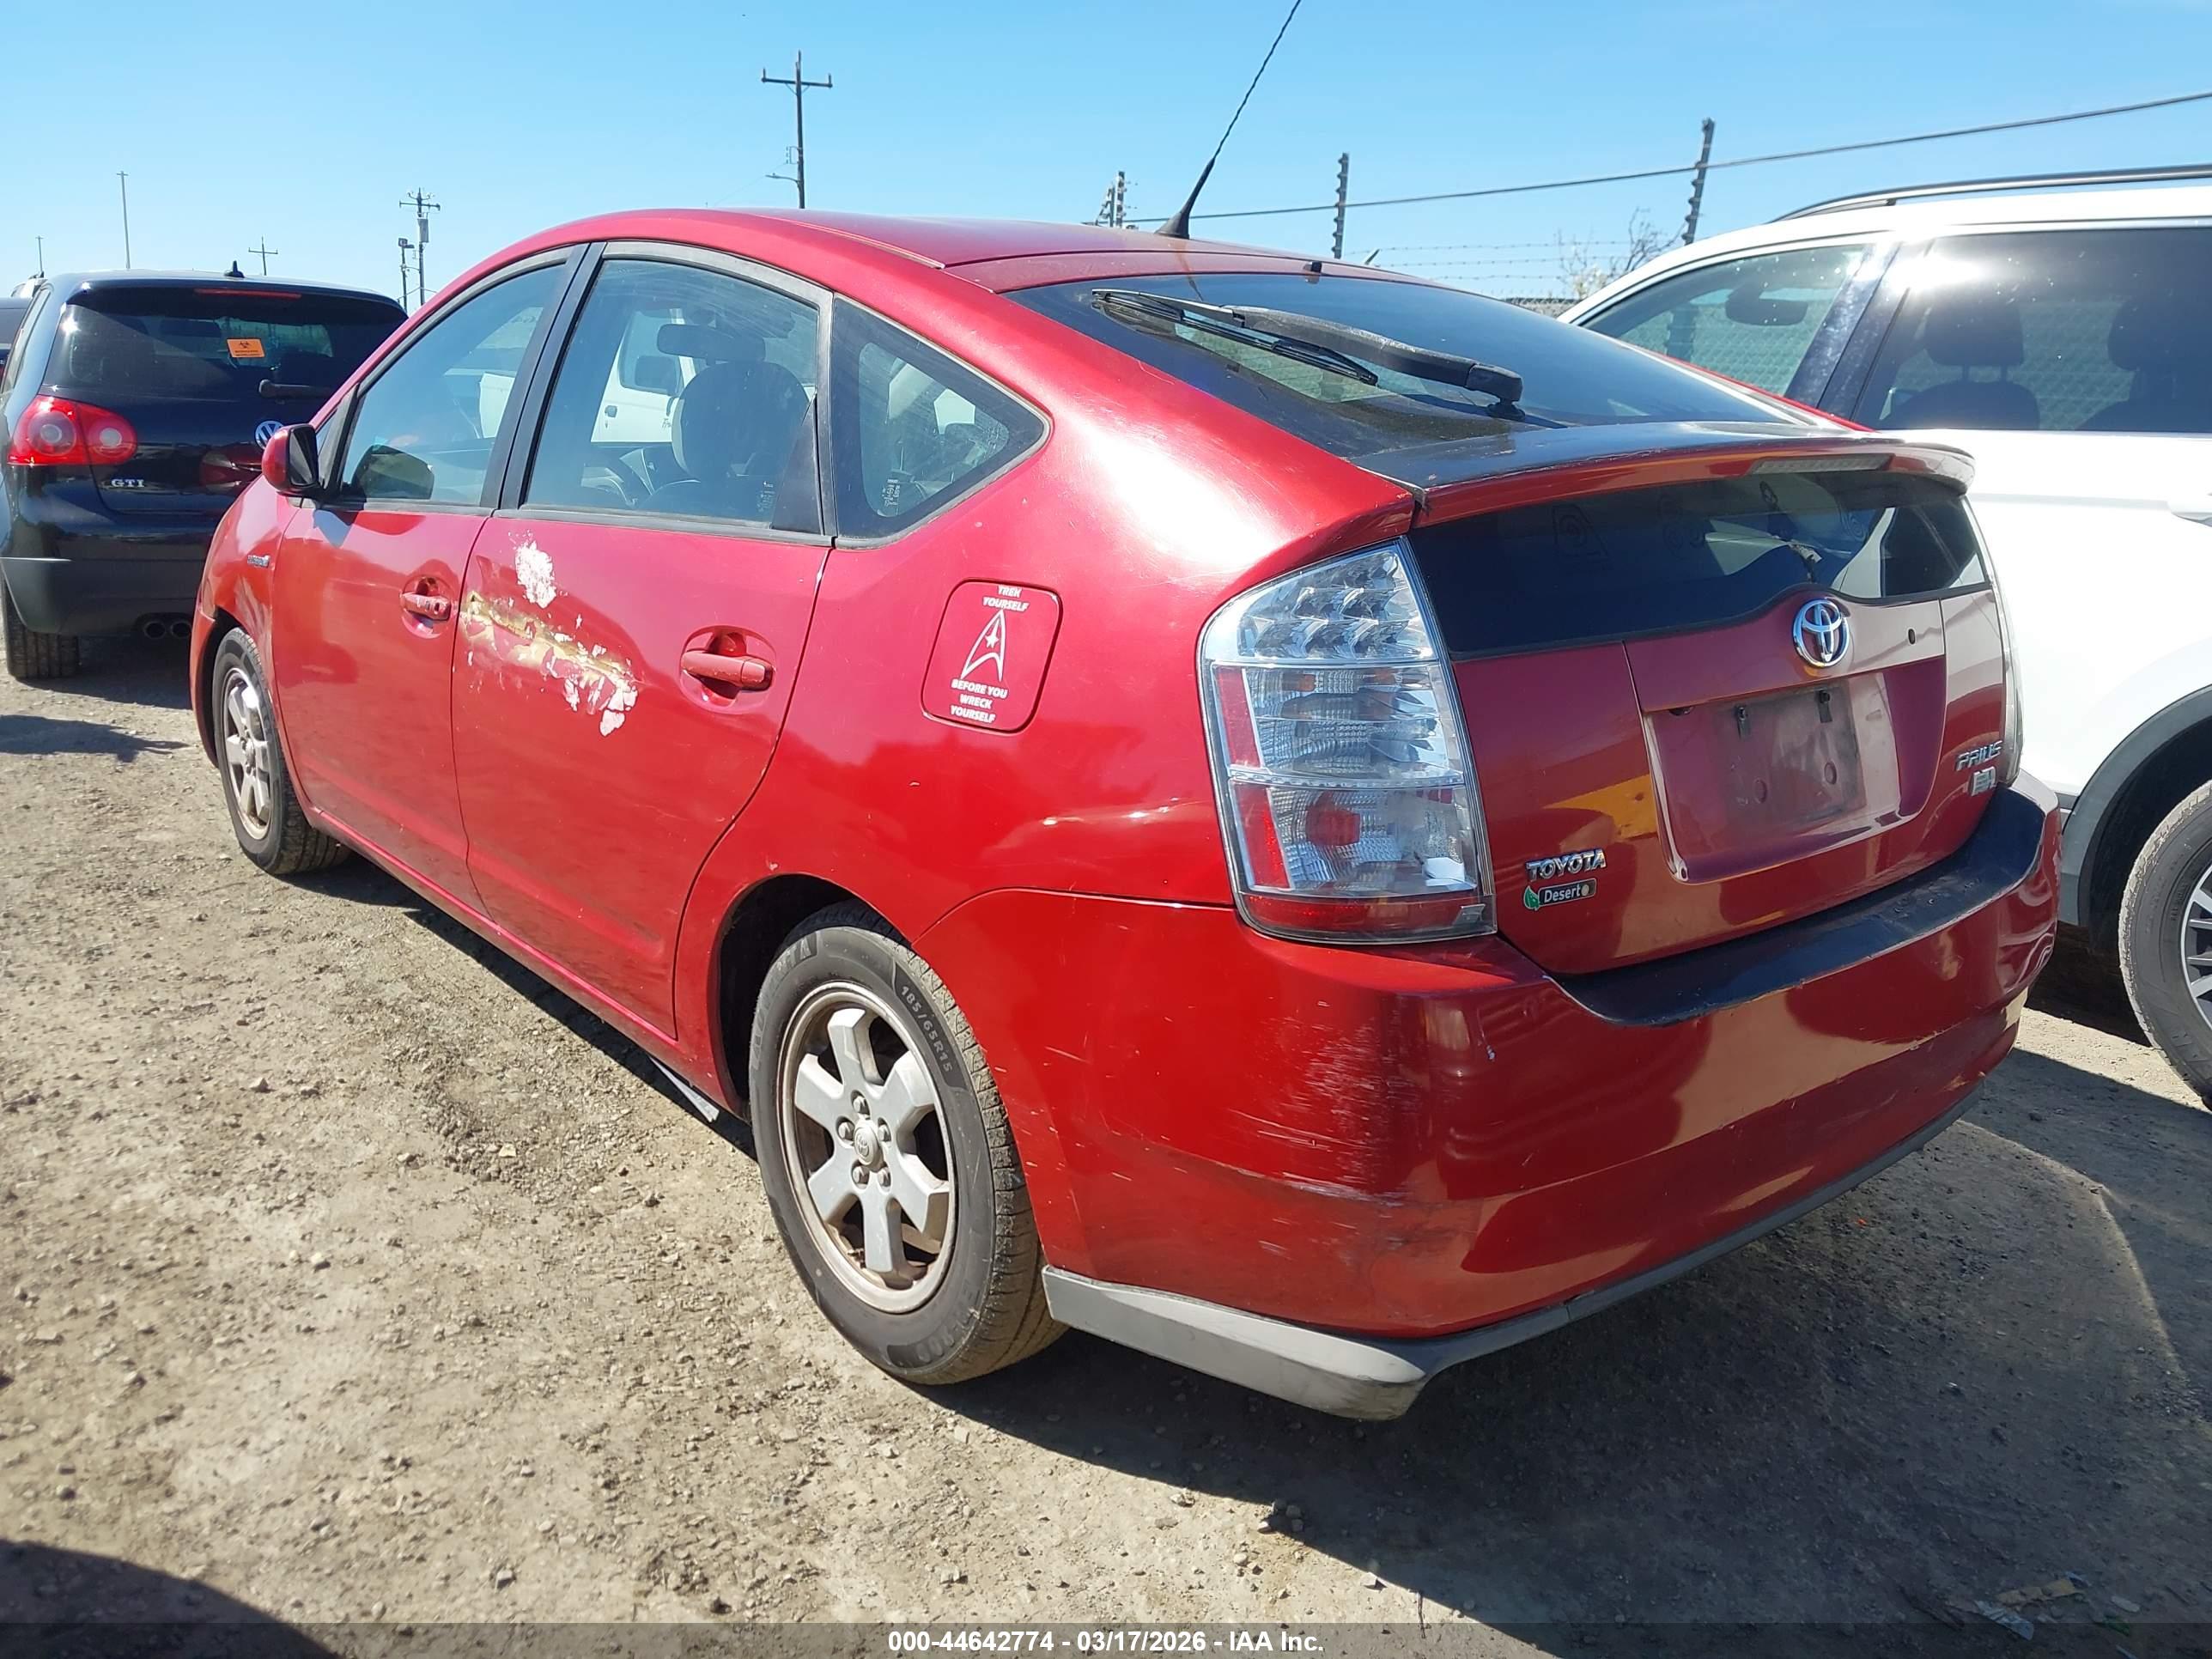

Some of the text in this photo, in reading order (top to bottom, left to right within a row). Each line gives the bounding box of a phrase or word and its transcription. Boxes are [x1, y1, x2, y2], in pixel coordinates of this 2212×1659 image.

[112, 478, 144, 487] GTI
[998, 586, 1022, 598] TREK
[982, 597, 1030, 611] YOURSELF
[951, 679, 1008, 698] BEFORE YOU
[960, 694, 993, 709] WRECK
[951, 705, 996, 723] YOURSELF
[1956, 740, 2002, 771] PRIUS
[1526, 848, 1607, 883] TOYOTA
[1544, 883, 1581, 903] Desert
[901, 985, 953, 1073] 185/65R15
